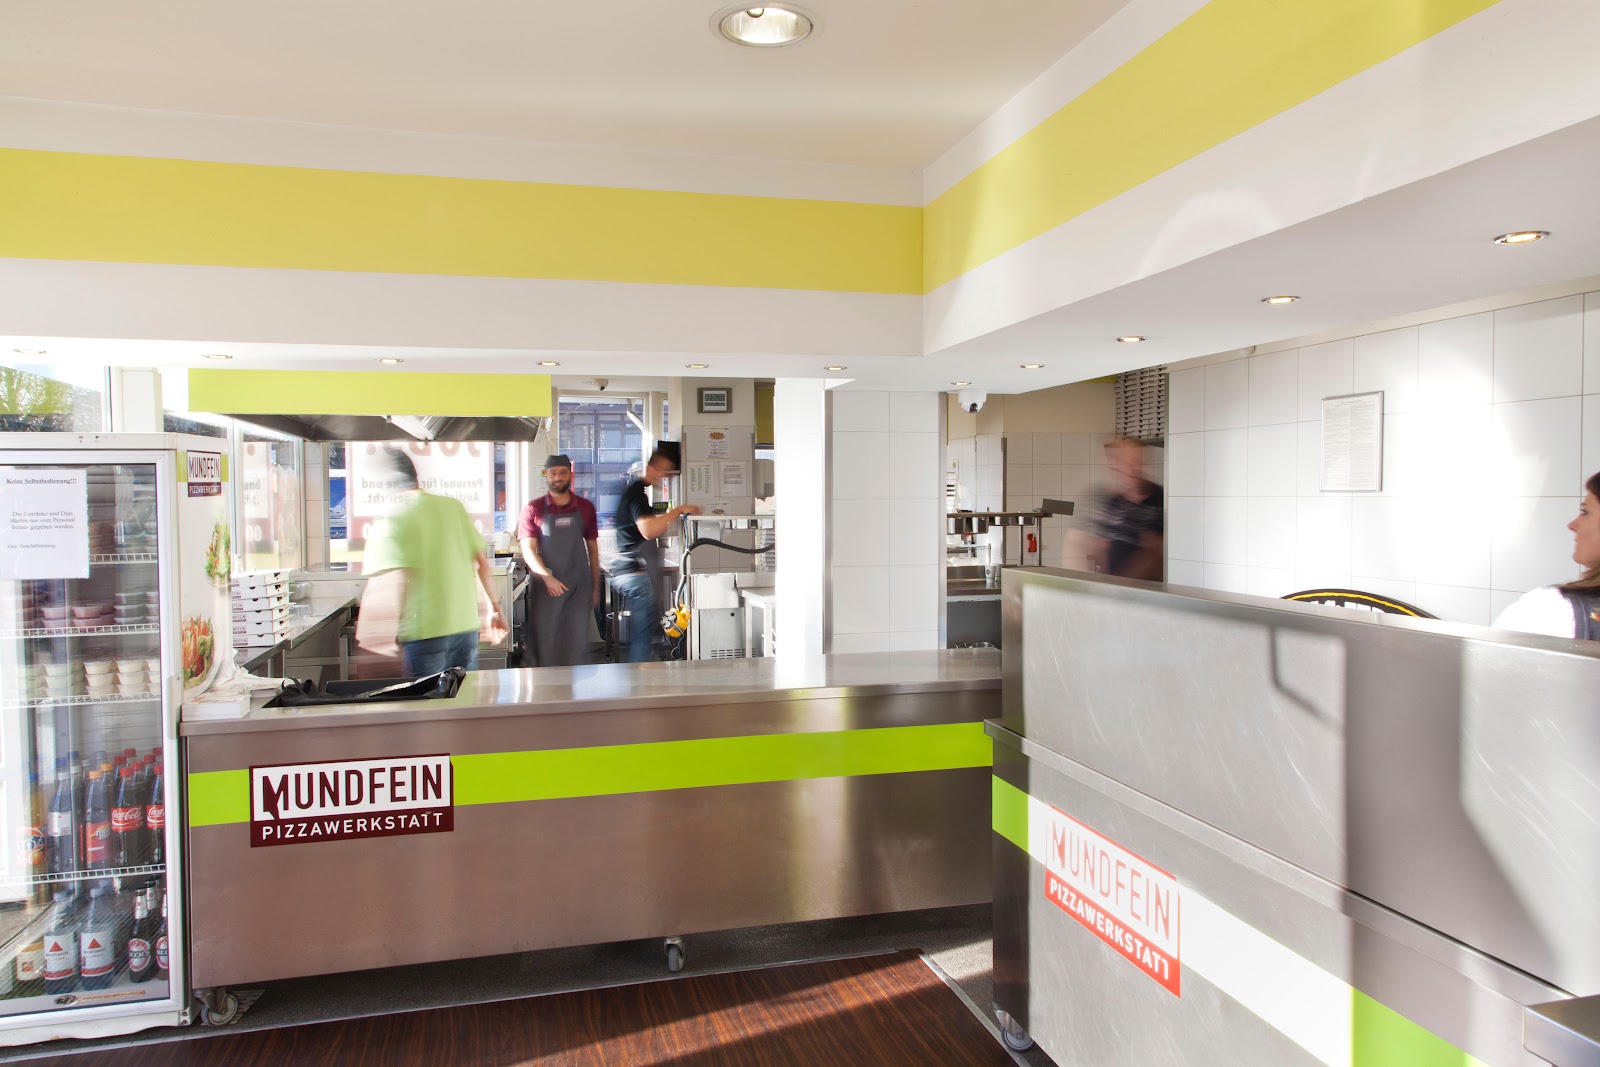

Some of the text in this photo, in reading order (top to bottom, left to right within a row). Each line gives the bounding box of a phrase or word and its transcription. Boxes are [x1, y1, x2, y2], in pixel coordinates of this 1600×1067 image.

[189, 456, 220, 478] MUNDFEIN
[262, 764, 442, 815] MUNDFEIN
[112, 807, 143, 823] Coca-Cola
[262, 812, 443, 840] PIZZAWERKSTATT
[1052, 820, 1169, 941] MUNDFEIN
[1050, 877, 1169, 981] PIZZAWERKSTATT
